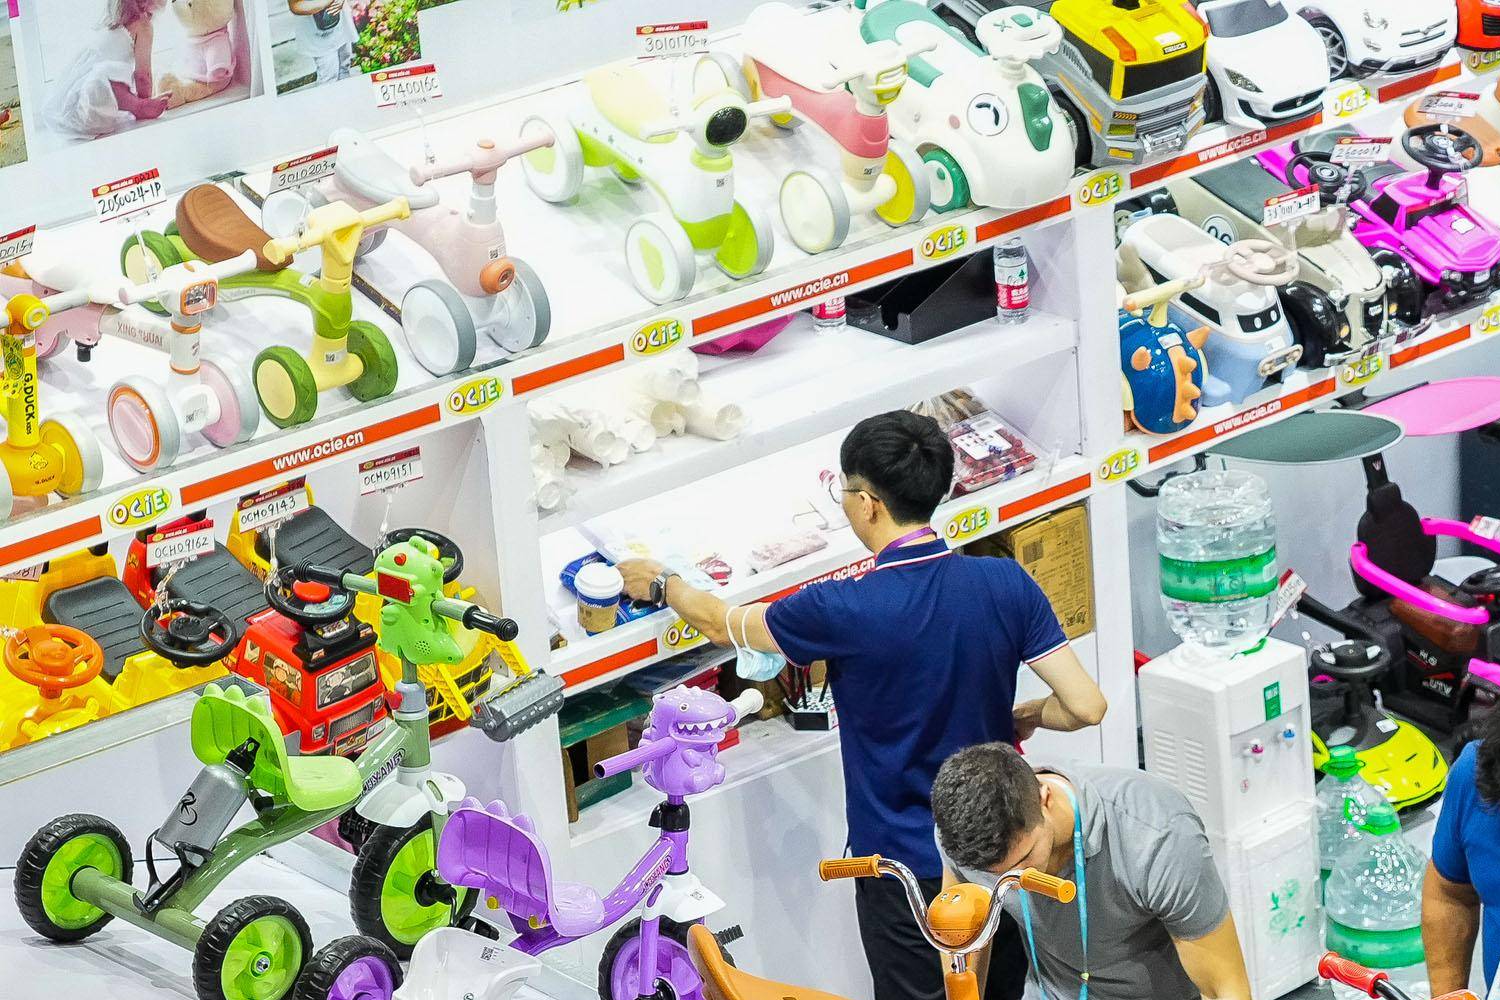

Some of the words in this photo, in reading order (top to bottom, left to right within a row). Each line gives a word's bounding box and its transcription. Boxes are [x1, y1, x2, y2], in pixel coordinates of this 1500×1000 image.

[771, 272, 849, 307] www.ocie.cn
[24, 373, 35, 421] G.DUCK
[273, 430, 364, 471] www.ocie.cn
